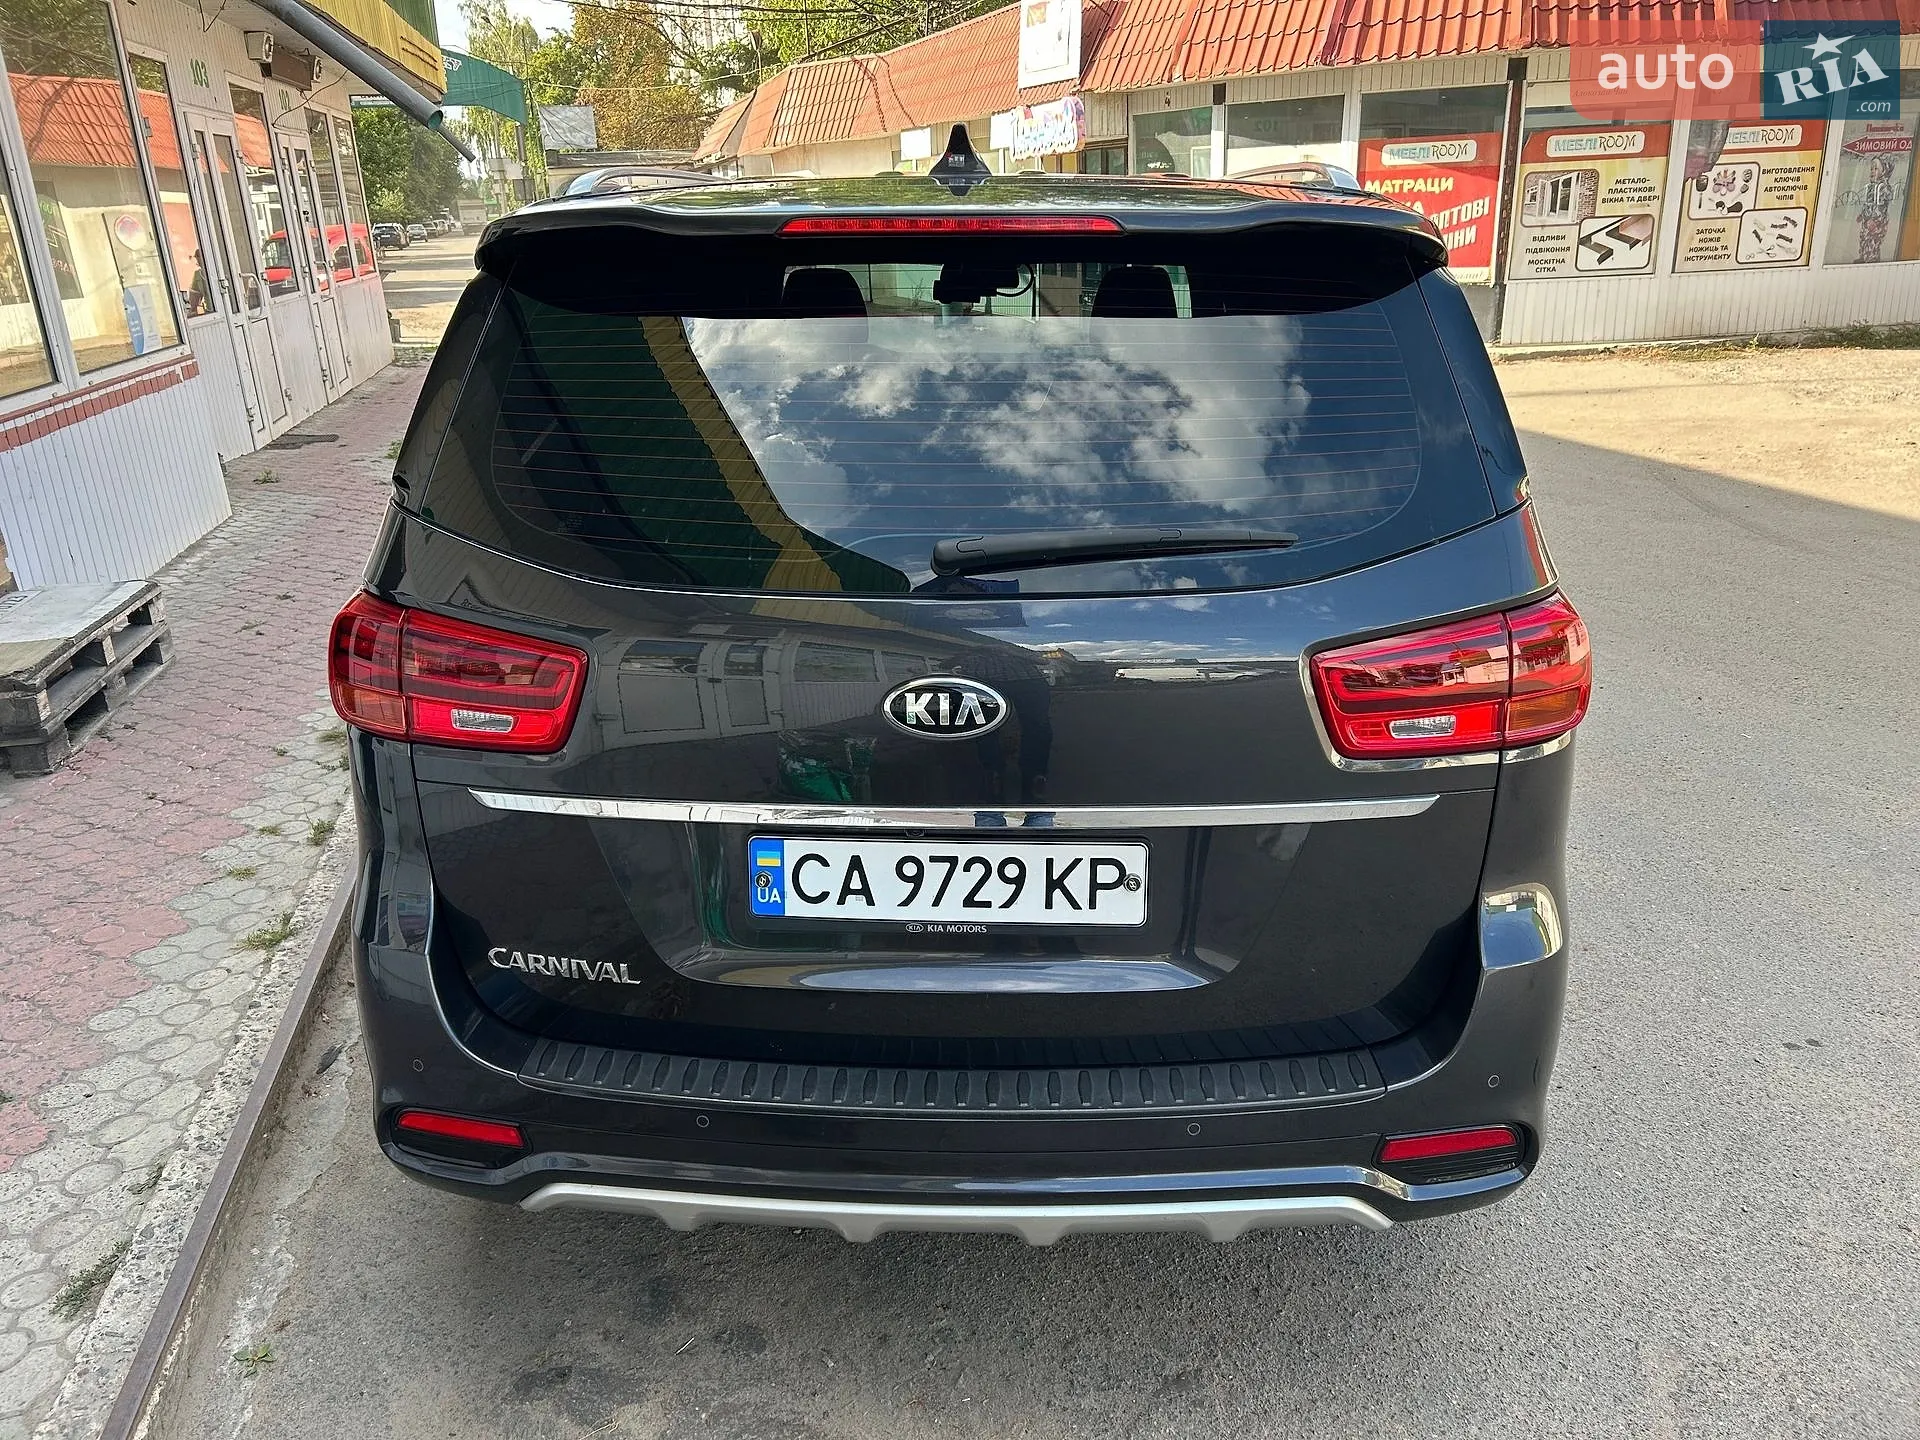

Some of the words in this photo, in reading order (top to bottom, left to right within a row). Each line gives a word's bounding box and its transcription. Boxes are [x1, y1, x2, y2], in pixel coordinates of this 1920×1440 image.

[190, 58, 209, 88] 103
[1855, 139, 1898, 150] ЗИМОВИЙ
[1762, 166, 1815, 175] ВИГОТОВЛЕННЯ
[1364, 176, 1454, 194] МАТРАЦИ
[1763, 184, 1808, 193] АВТОКЛЮЧІВ
[1608, 186, 1656, 194] ПЛАСТИКОВІ
[1601, 196, 1624, 204] ВІКНА
[1636, 195, 1660, 203] ДВЕРІ
[1695, 227, 1726, 235] ЗАТОЧКА
[1532, 234, 1566, 242] ВІДЛИВИ
[1525, 246, 1571, 254] ПІДВІКОННЯ
[1688, 245, 1719, 253] НОЖИЦЬ
[1527, 258, 1566, 266] МОСКІТНА
[1684, 253, 1732, 262] ІНСТРУМЕНТУ
[904, 692, 987, 726] KIA
[791, 853, 875, 907] CA
[895, 855, 1027, 909] 9729
[1044, 857, 1126, 910] KP
[757, 887, 782, 903] UA
[927, 924, 944, 932] KIA
[946, 924, 987, 933] MOTORS
[487, 947, 641, 985] CARNIVAL
